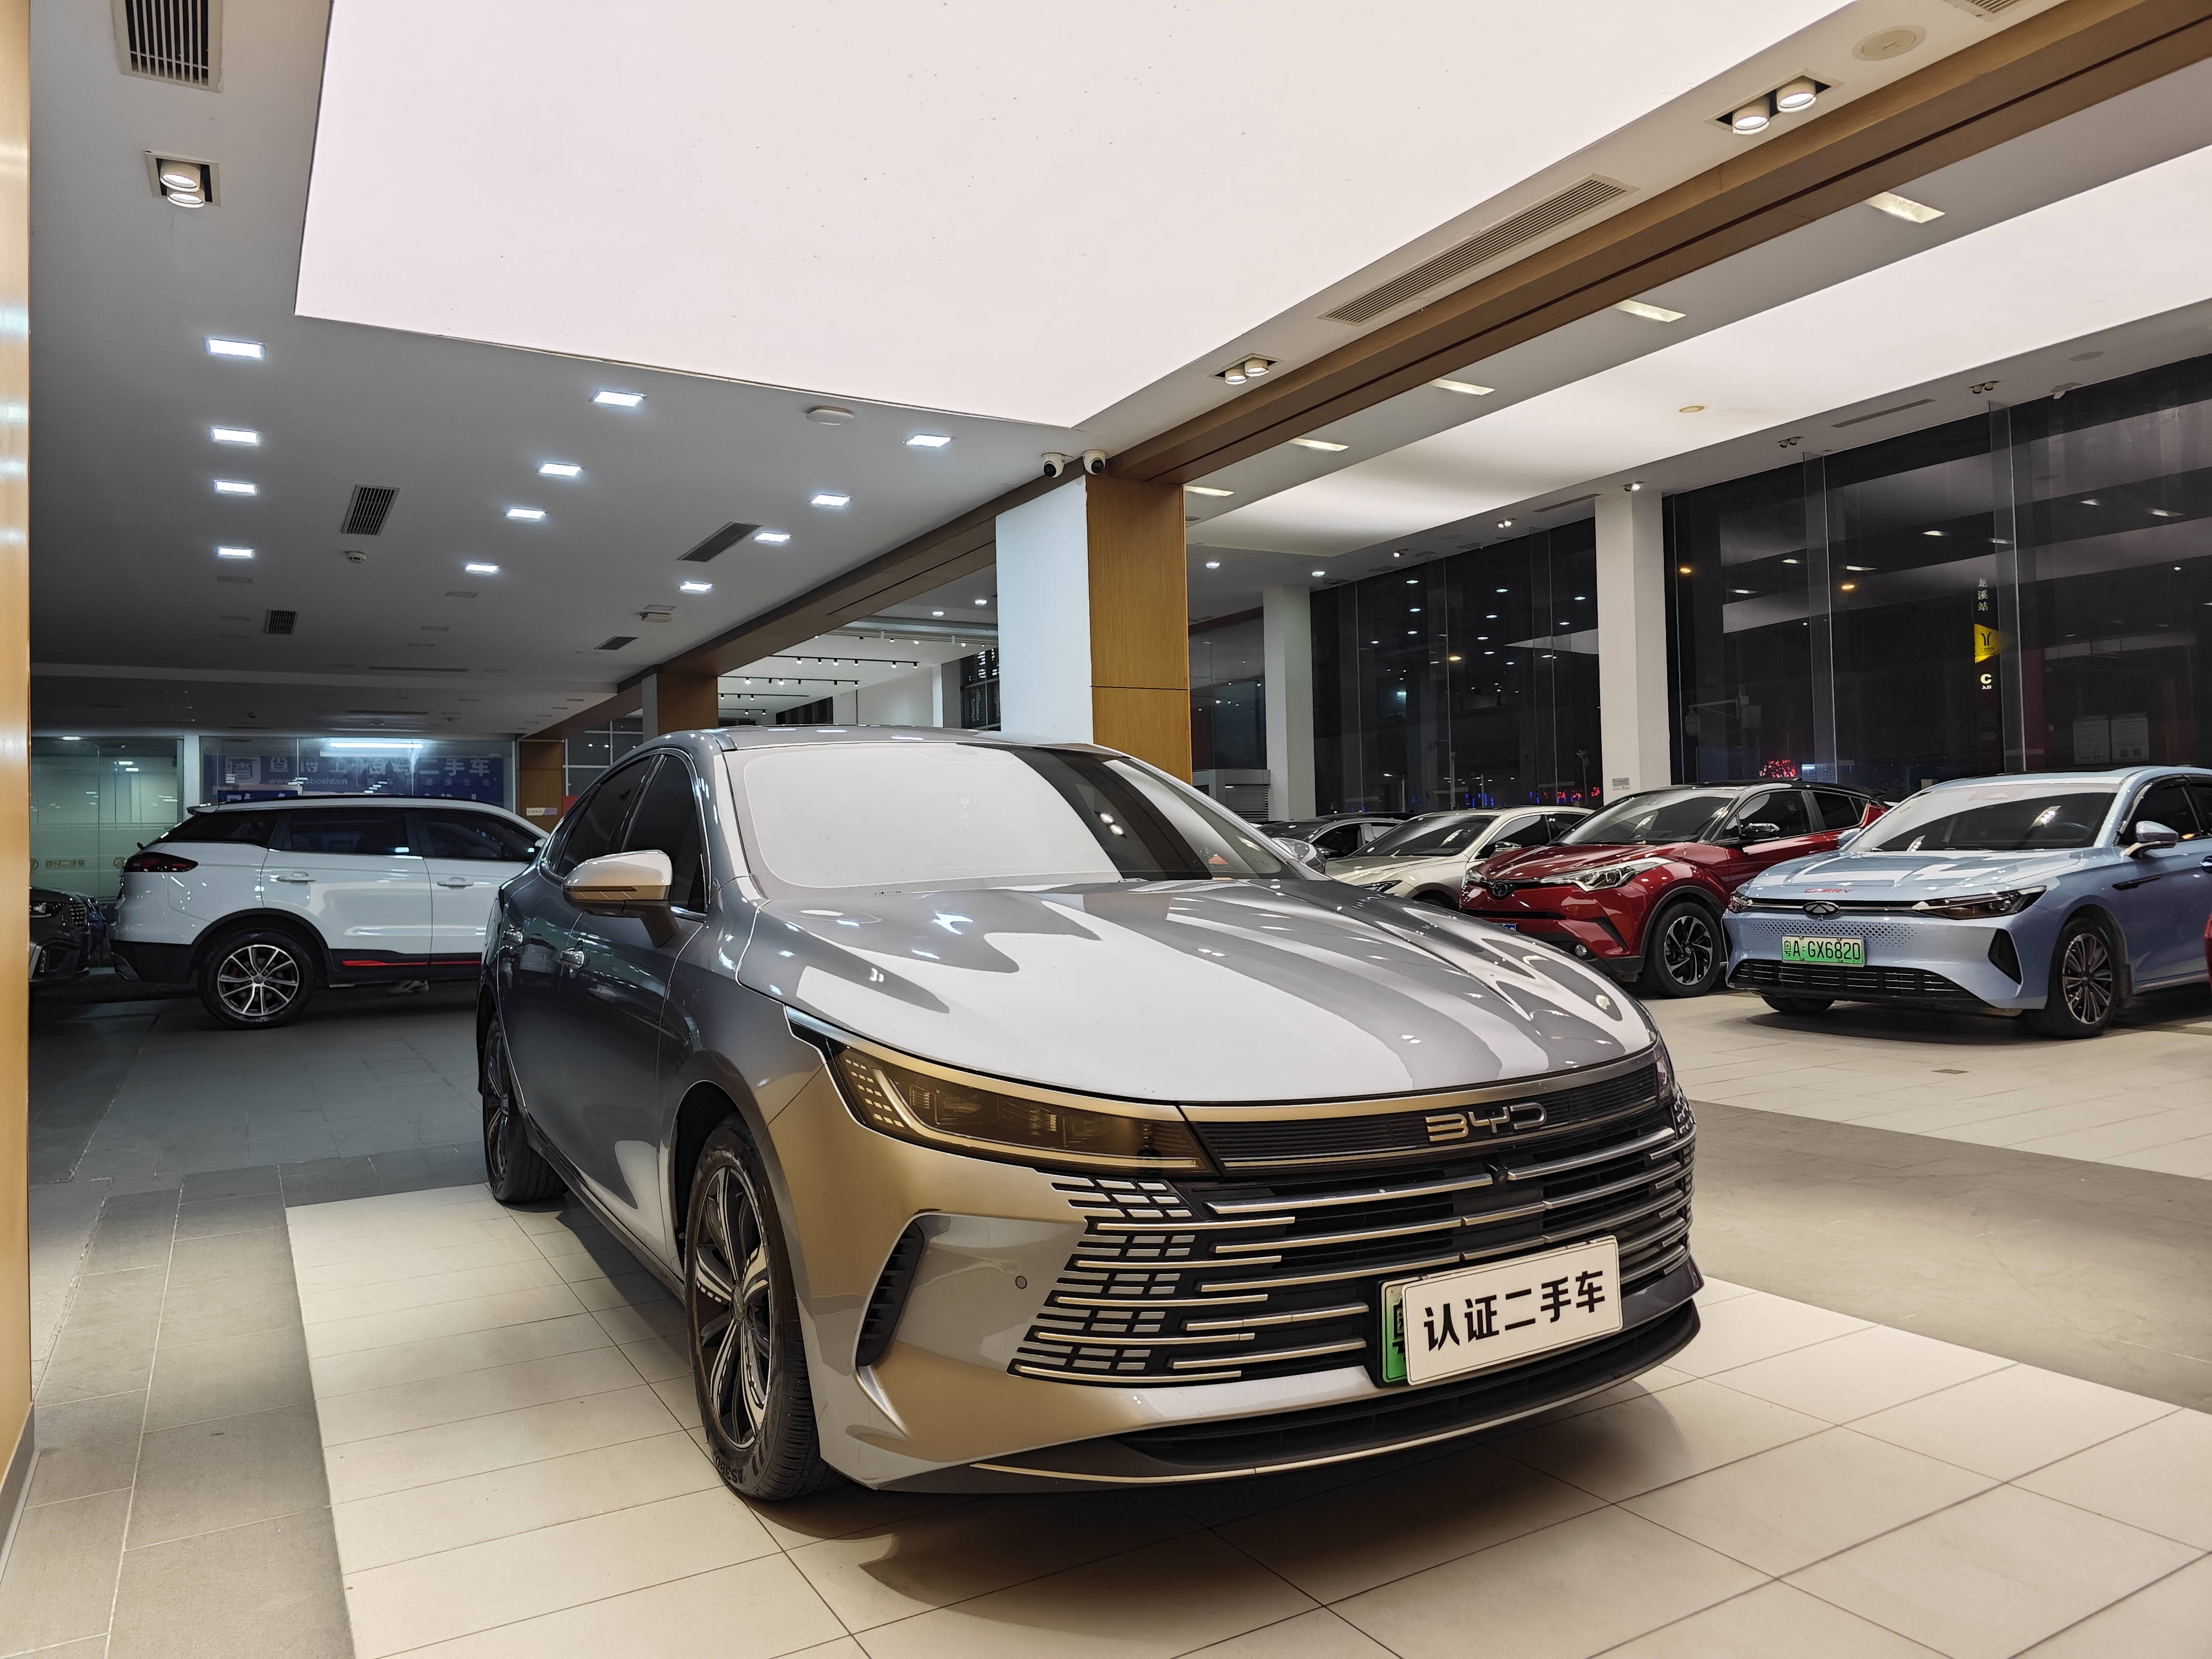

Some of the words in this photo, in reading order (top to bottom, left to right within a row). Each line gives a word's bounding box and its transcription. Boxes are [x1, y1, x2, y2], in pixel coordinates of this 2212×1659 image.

[1977, 578, 1988, 611] 龙溪站
[1980, 673, 1992, 684] C
[1424, 1102, 1547, 1142] BYD
[1424, 1270, 1606, 1352] 认证二手车
